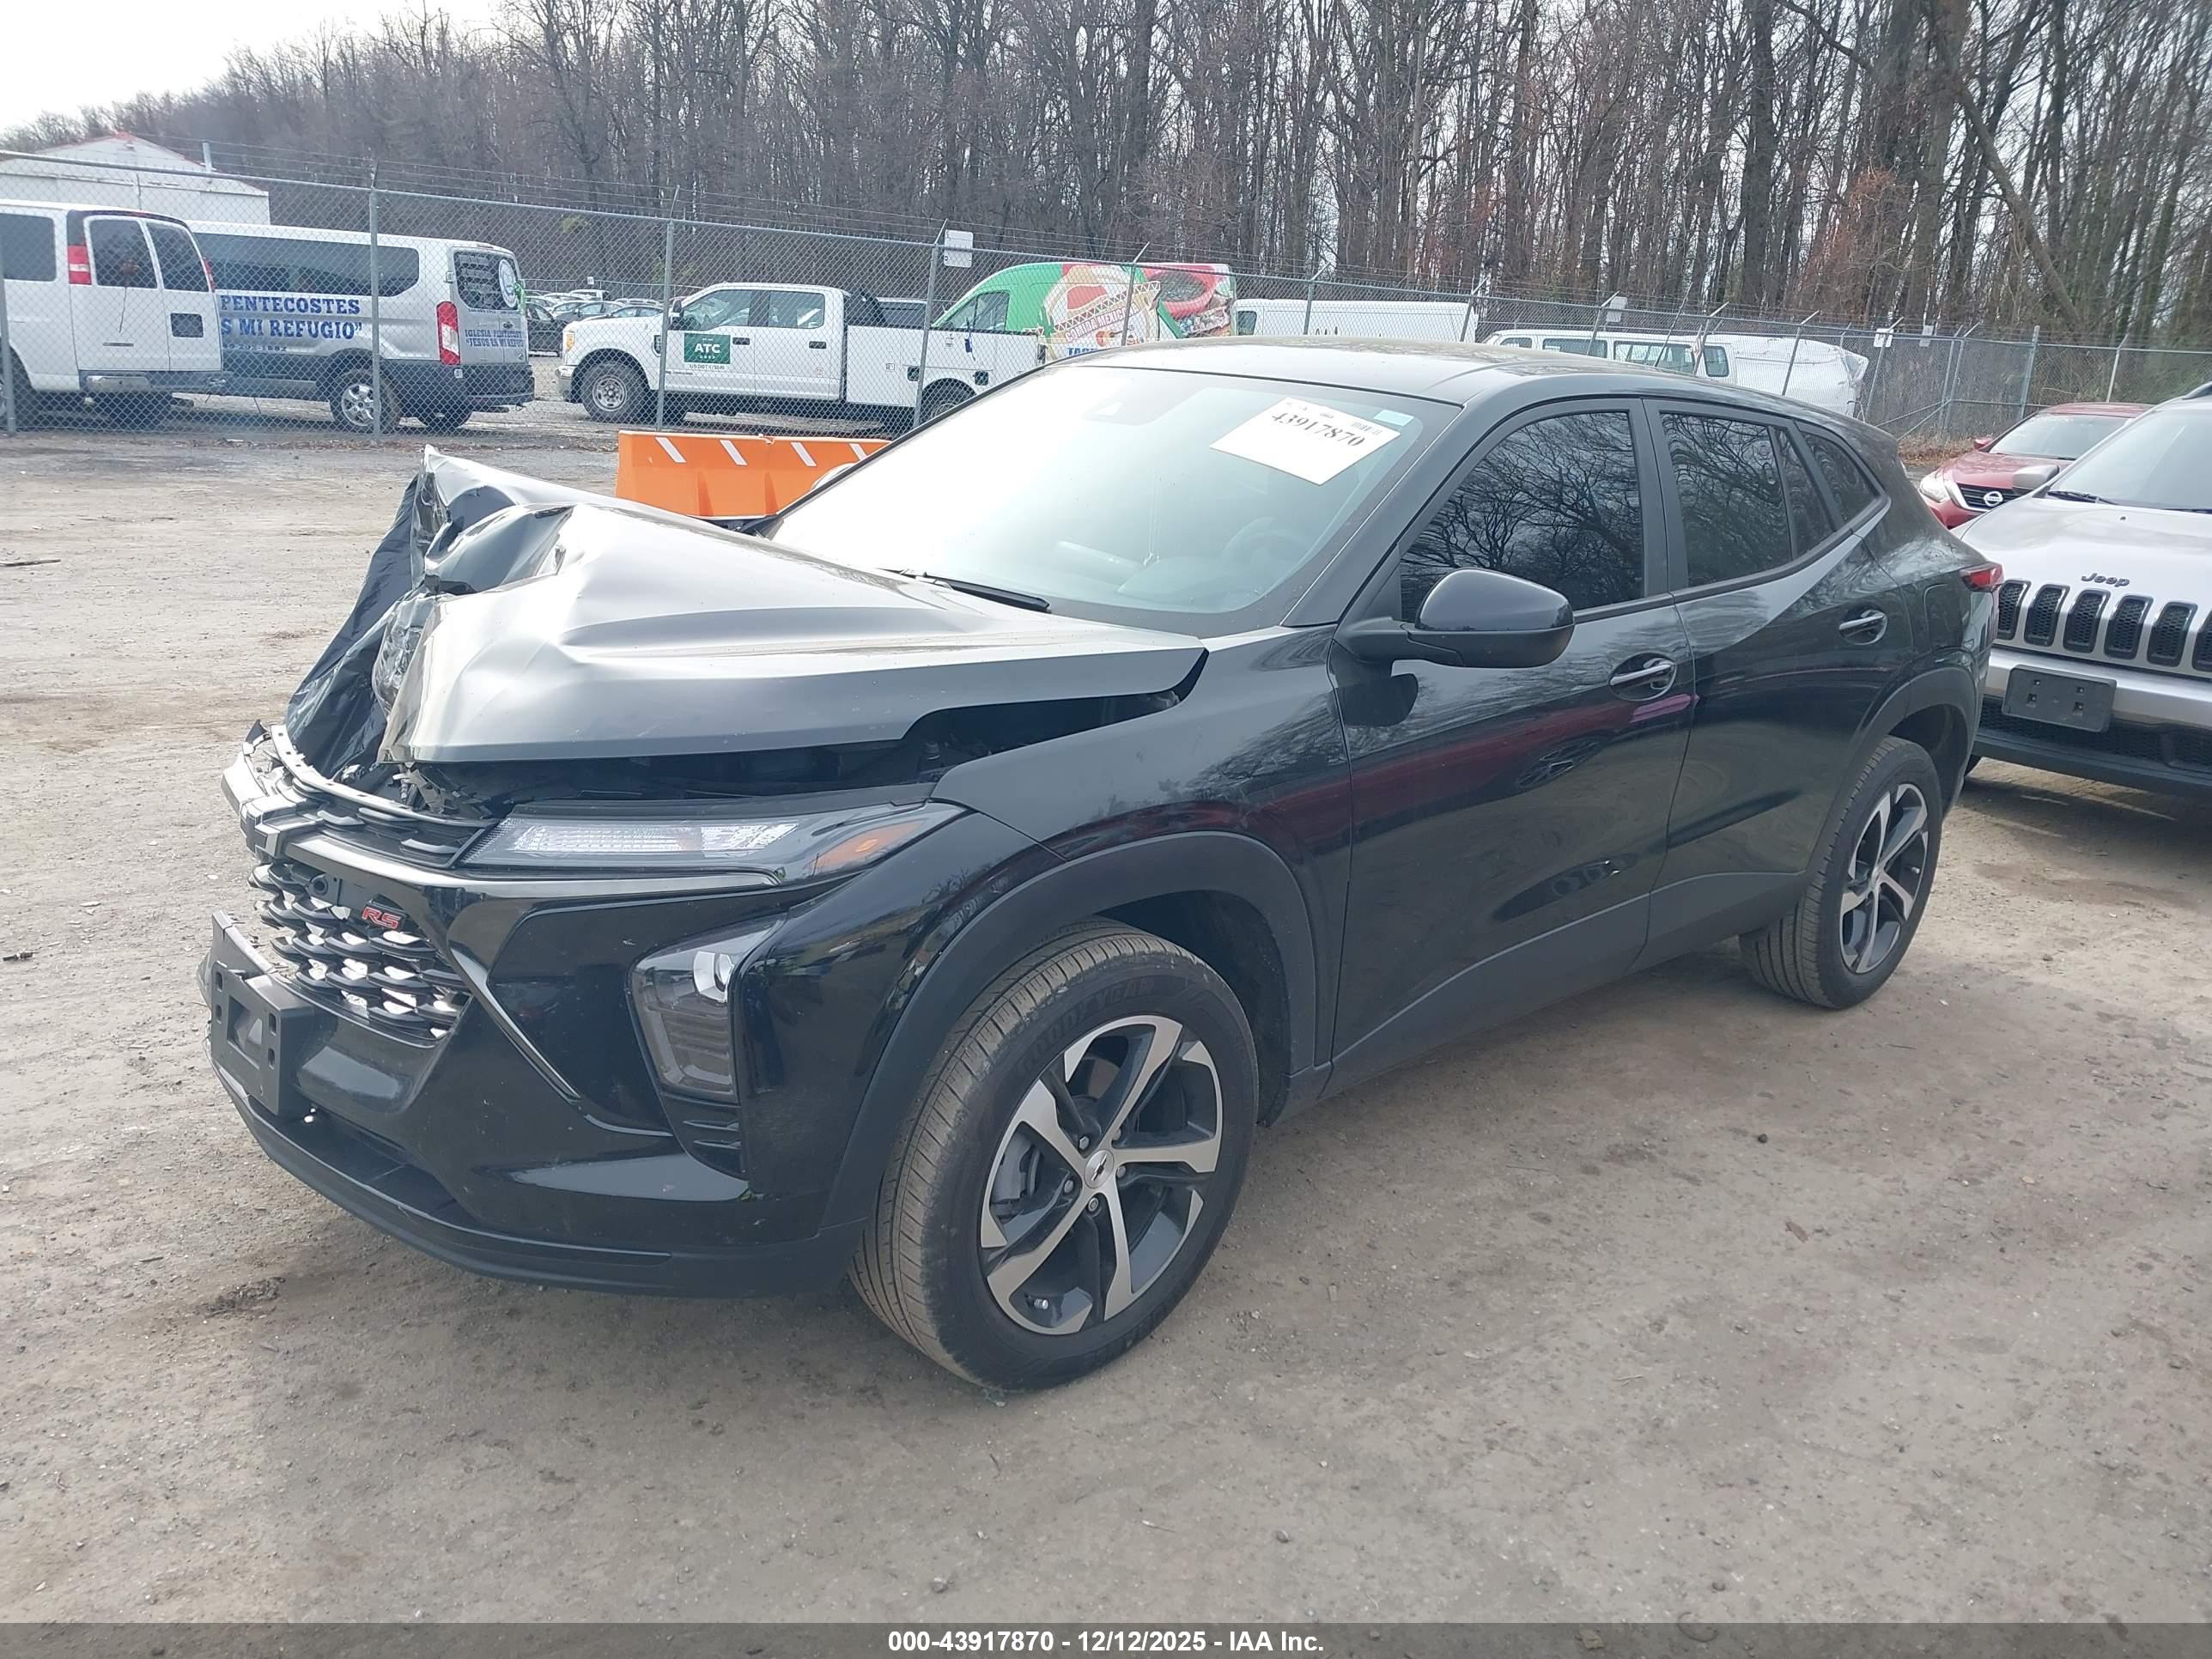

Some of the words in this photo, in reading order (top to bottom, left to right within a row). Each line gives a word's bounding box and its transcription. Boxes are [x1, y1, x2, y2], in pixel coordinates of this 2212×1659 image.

[220, 295, 361, 315] PENTECOSTES
[239, 318, 264, 336] MI
[1065, 320, 1099, 343] COMIDA
[694, 343, 721, 354] ATC
[1272, 412, 1365, 447] 43917870
[2081, 572, 2130, 588] Jeep
[362, 907, 402, 929] RS
